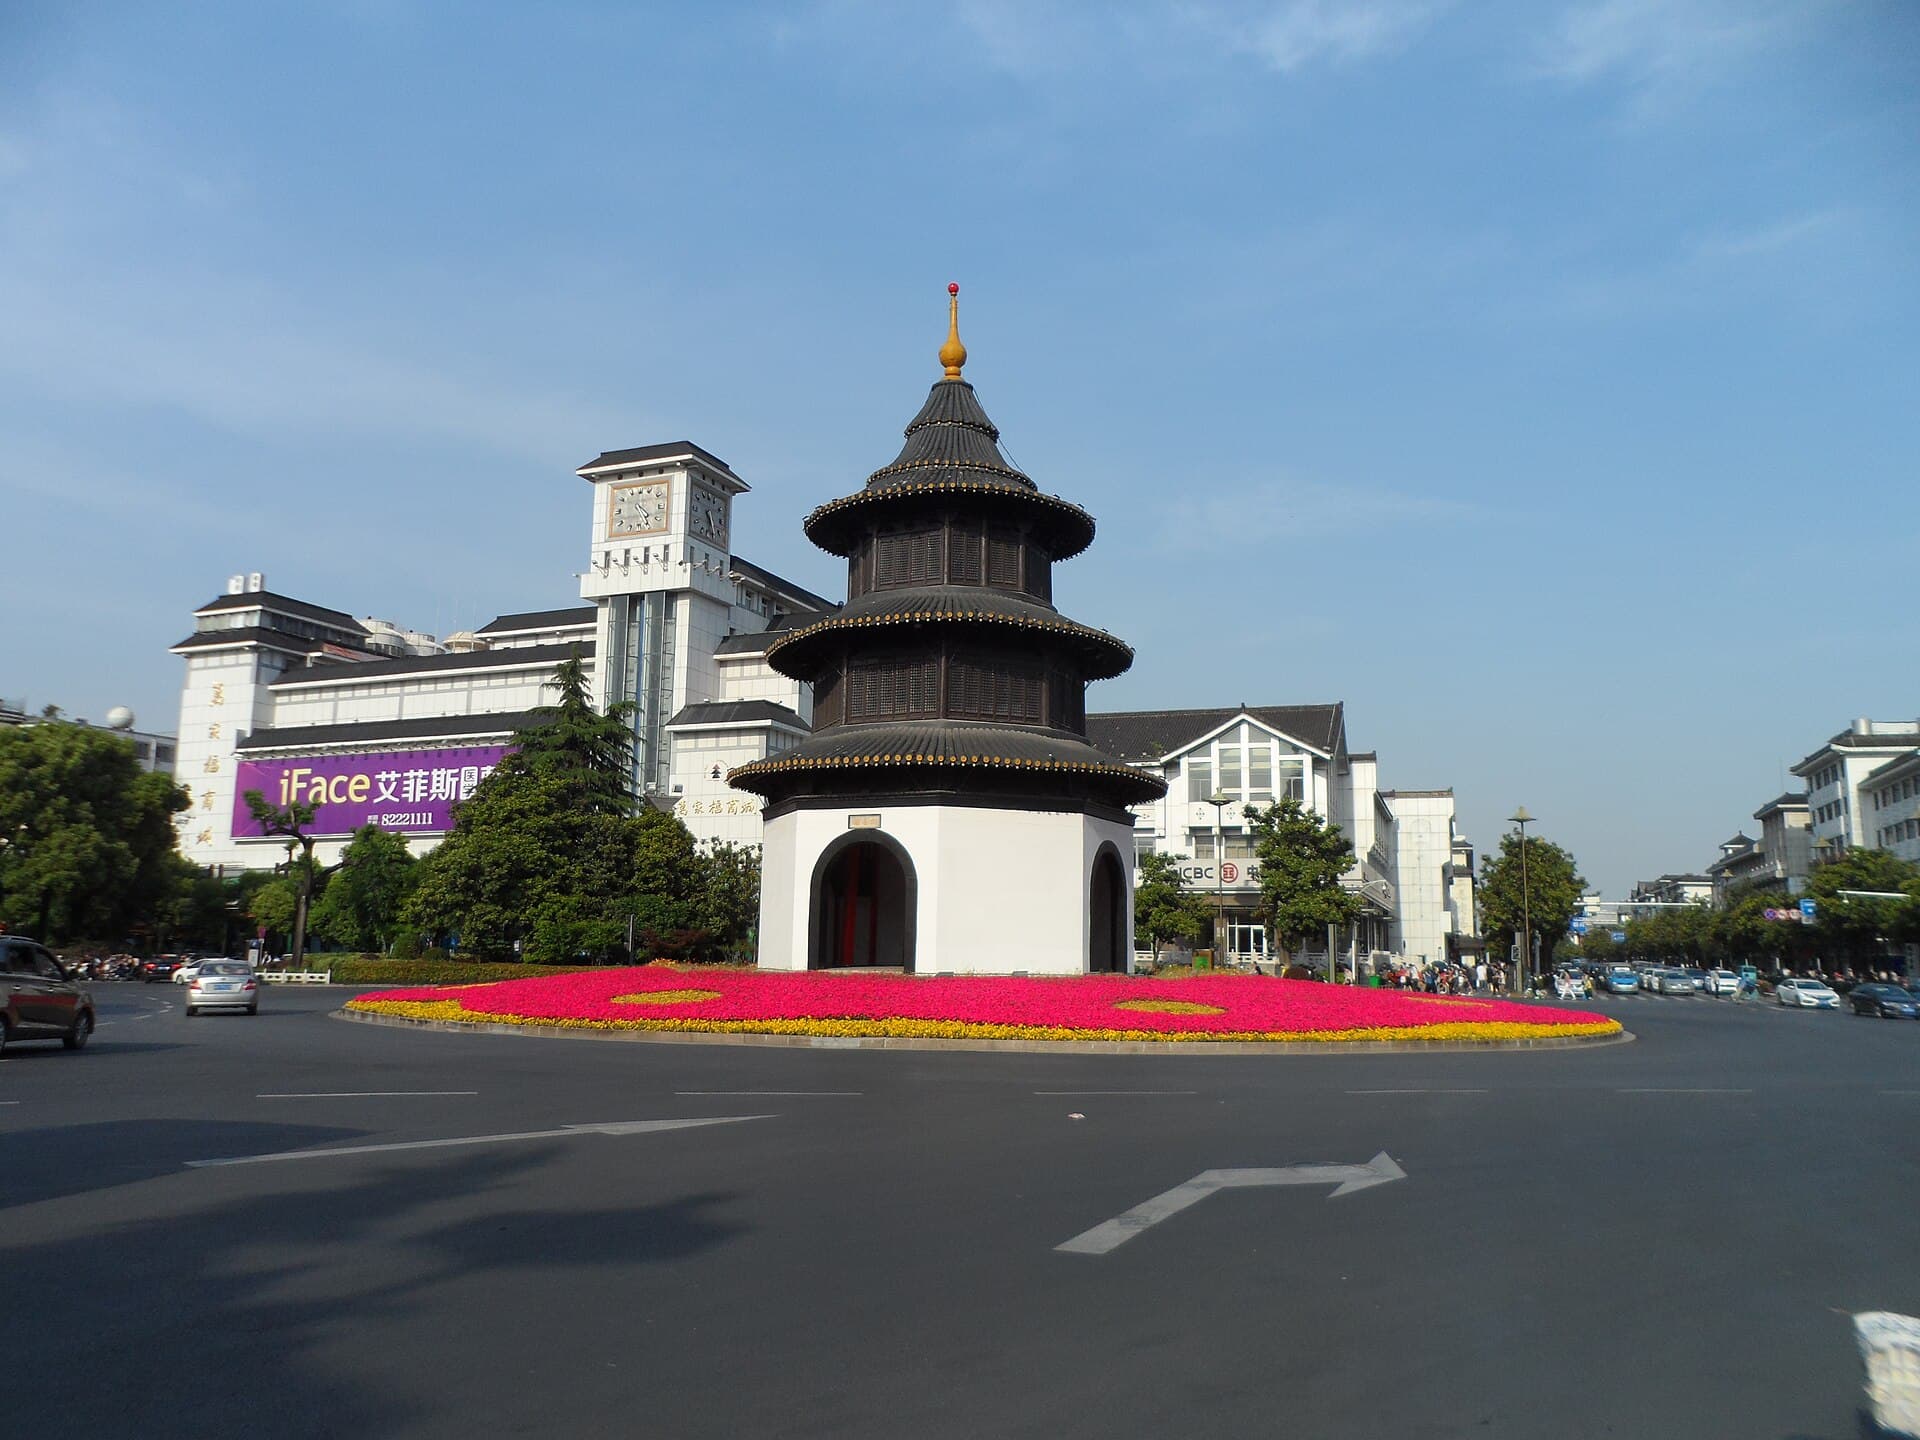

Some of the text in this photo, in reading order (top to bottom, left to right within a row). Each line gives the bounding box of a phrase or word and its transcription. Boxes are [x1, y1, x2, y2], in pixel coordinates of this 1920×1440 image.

[280, 768, 371, 806] iFace
[382, 812, 433, 825] 82221111
[1179, 867, 1214, 879] ICBC
